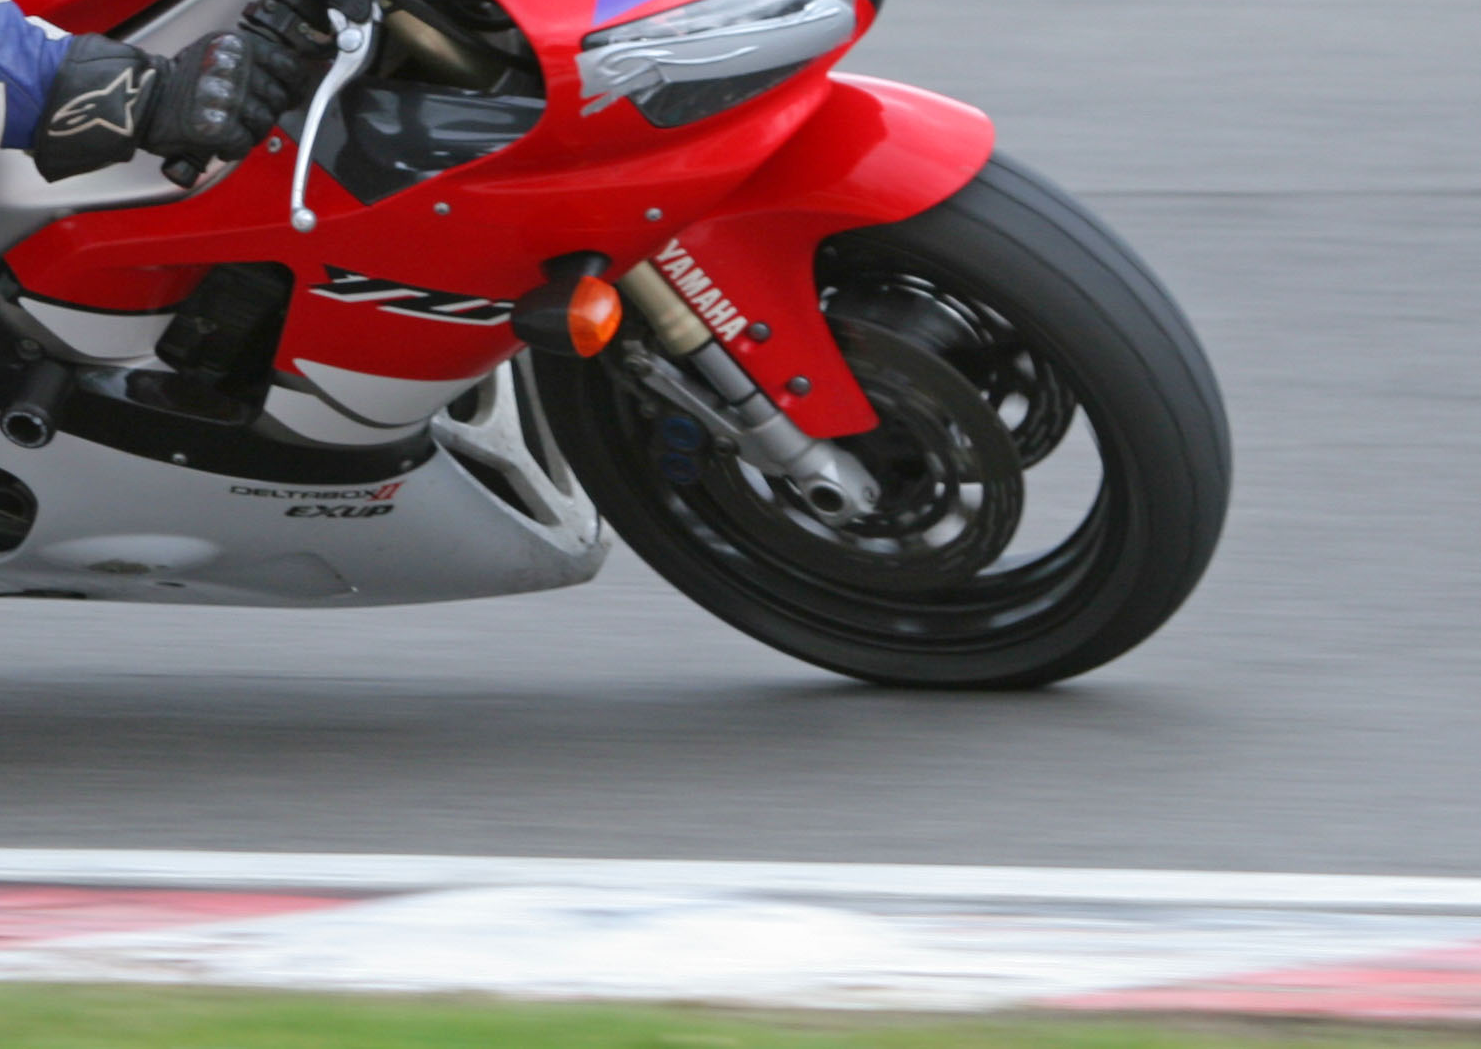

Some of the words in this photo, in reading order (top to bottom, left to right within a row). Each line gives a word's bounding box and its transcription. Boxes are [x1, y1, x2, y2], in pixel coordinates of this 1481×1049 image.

[655, 237, 748, 342] YAMAHA
[229, 484, 378, 501] DELTABOX
[285, 504, 395, 518] EXUP
